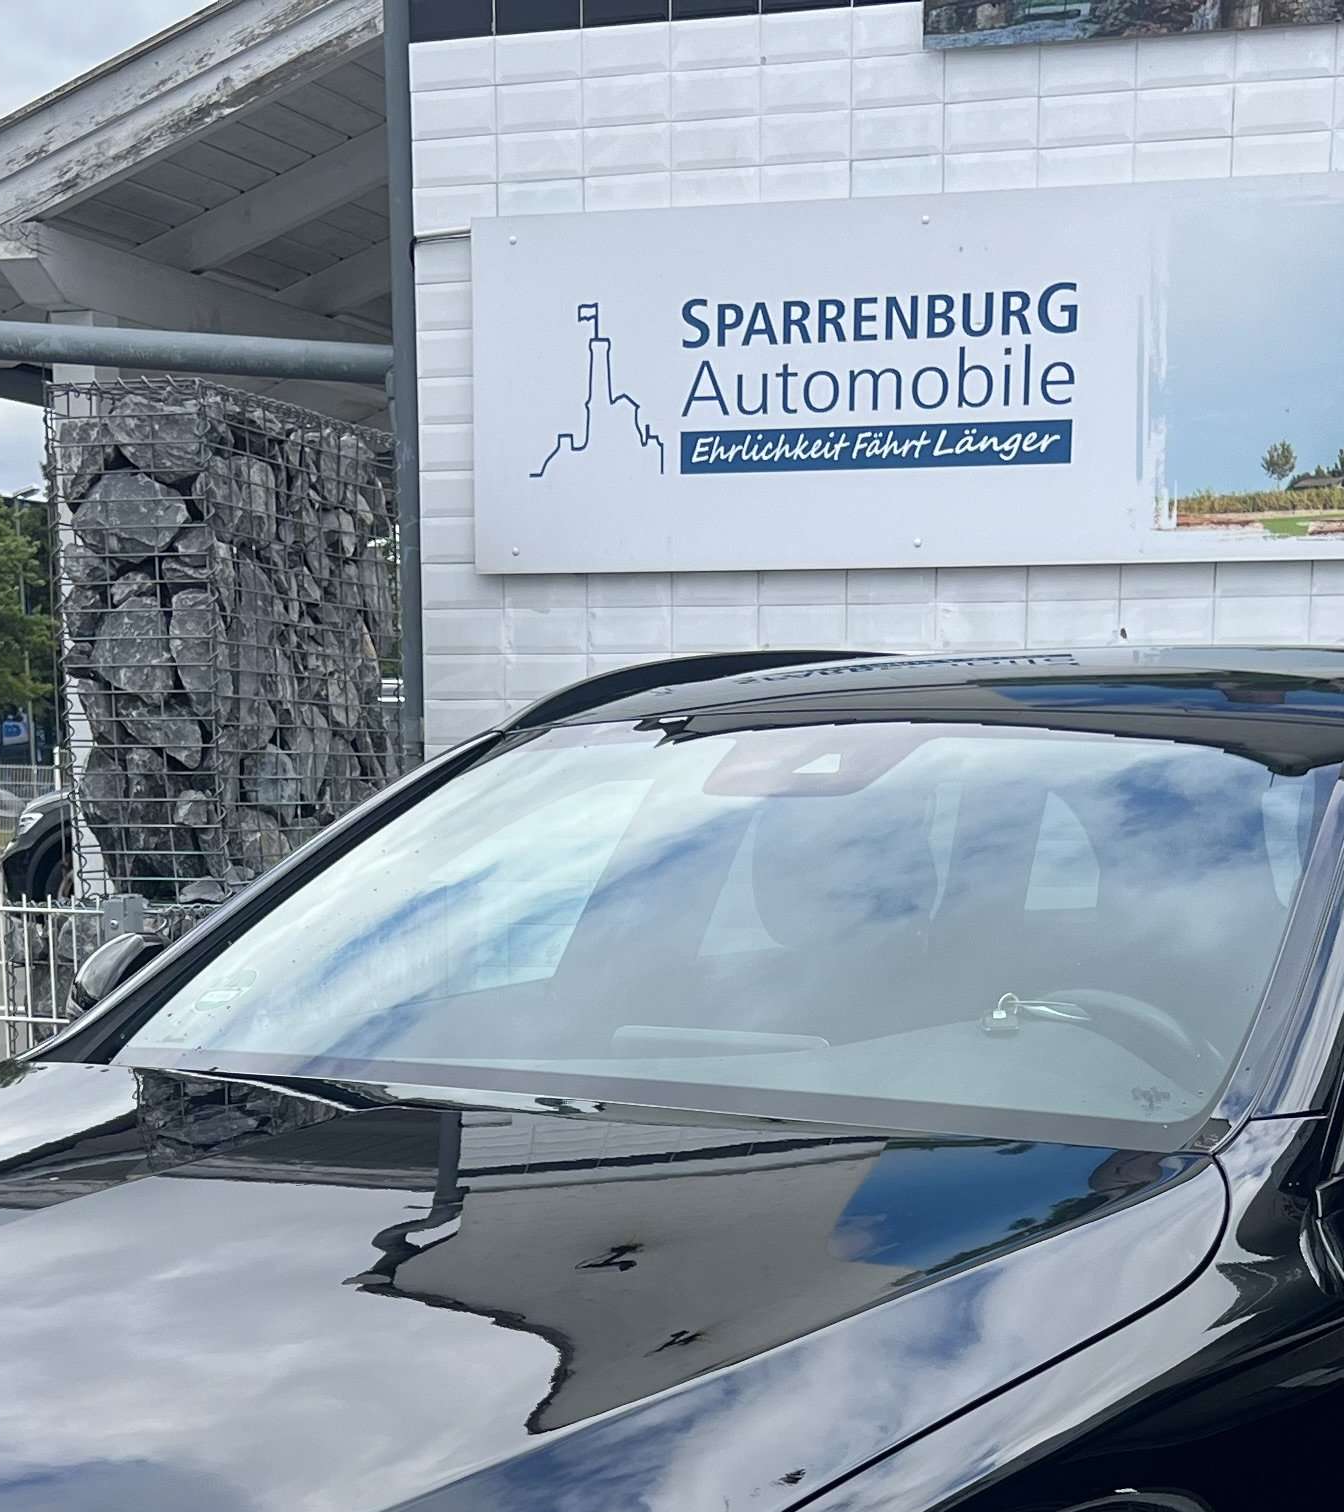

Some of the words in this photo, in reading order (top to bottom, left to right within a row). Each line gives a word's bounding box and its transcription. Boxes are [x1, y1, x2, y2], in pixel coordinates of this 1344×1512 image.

[681, 282, 1078, 348] SPARRENBURG
[681, 344, 1076, 417] Automobile
[691, 431, 850, 464] Ehrlichkeit
[851, 429, 931, 459] Fährt
[933, 426, 1060, 461] Länger
